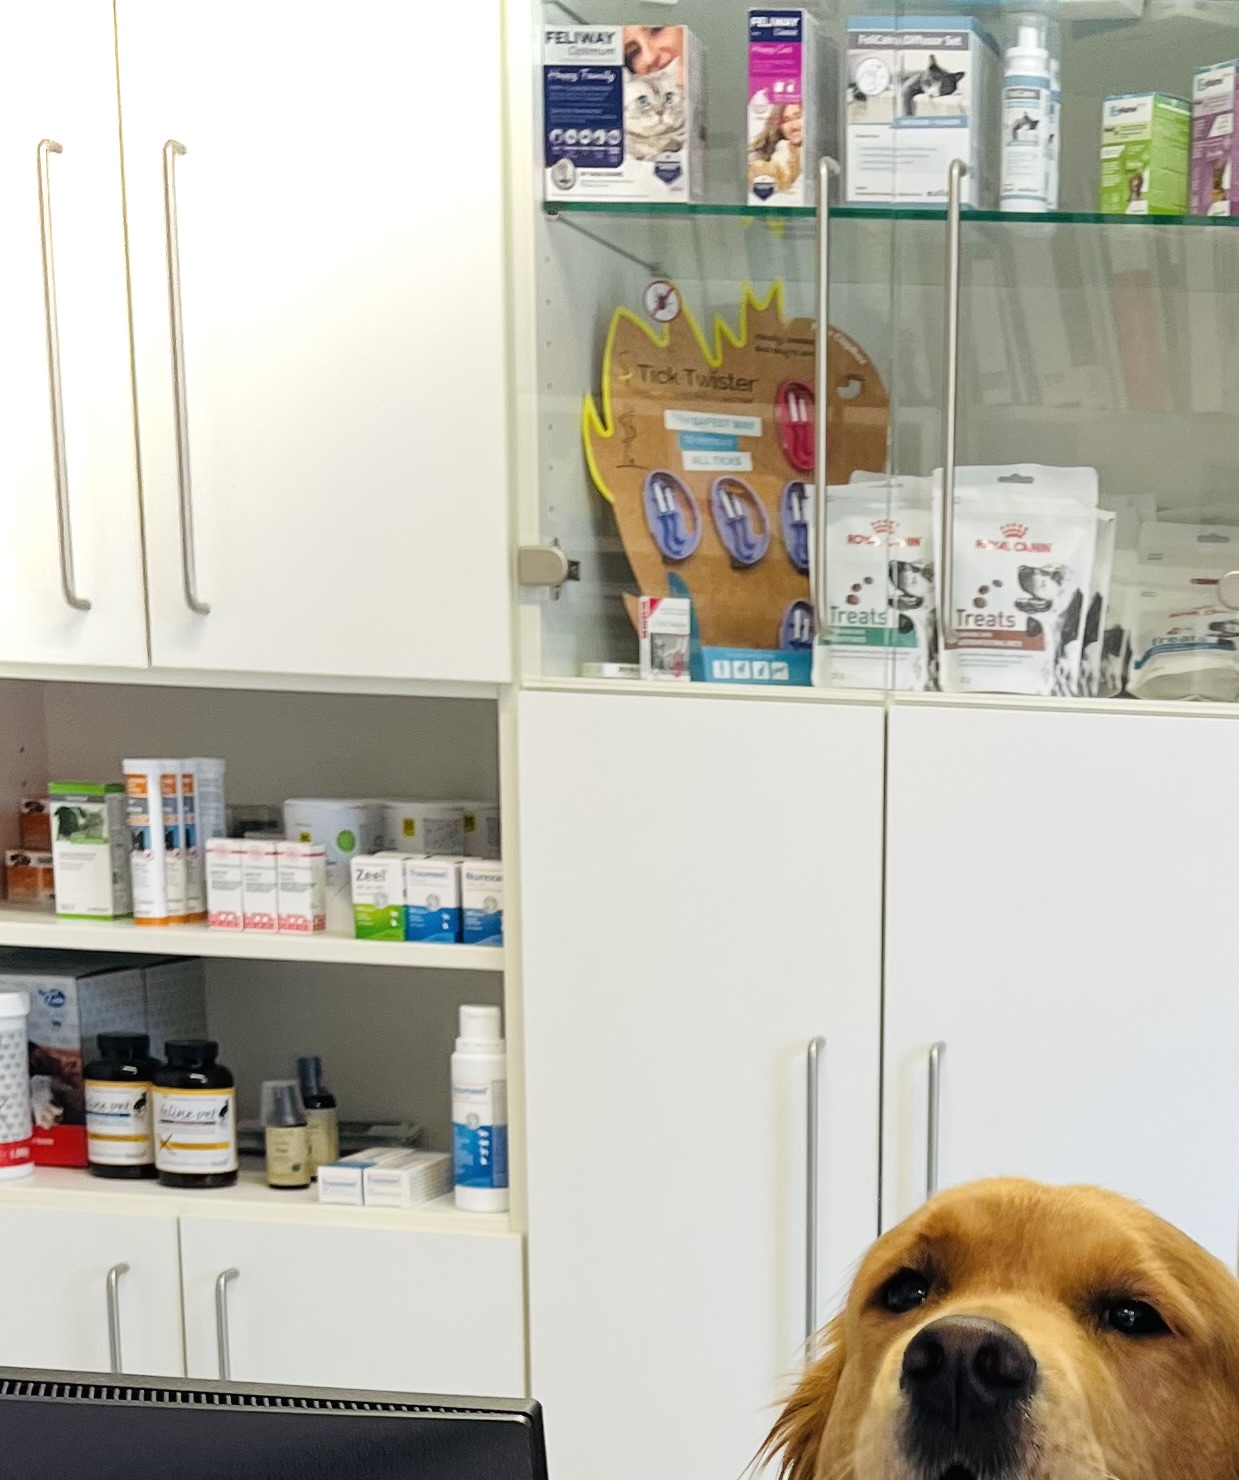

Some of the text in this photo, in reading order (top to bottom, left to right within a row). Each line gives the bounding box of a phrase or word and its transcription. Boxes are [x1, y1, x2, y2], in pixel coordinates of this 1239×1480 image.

[545, 31, 617, 45] FELIWAY
[637, 363, 759, 394] Tick Twister
[829, 605, 887, 626] Treats
[955, 608, 1017, 628] Treats
[356, 868, 386, 883] Zeel
